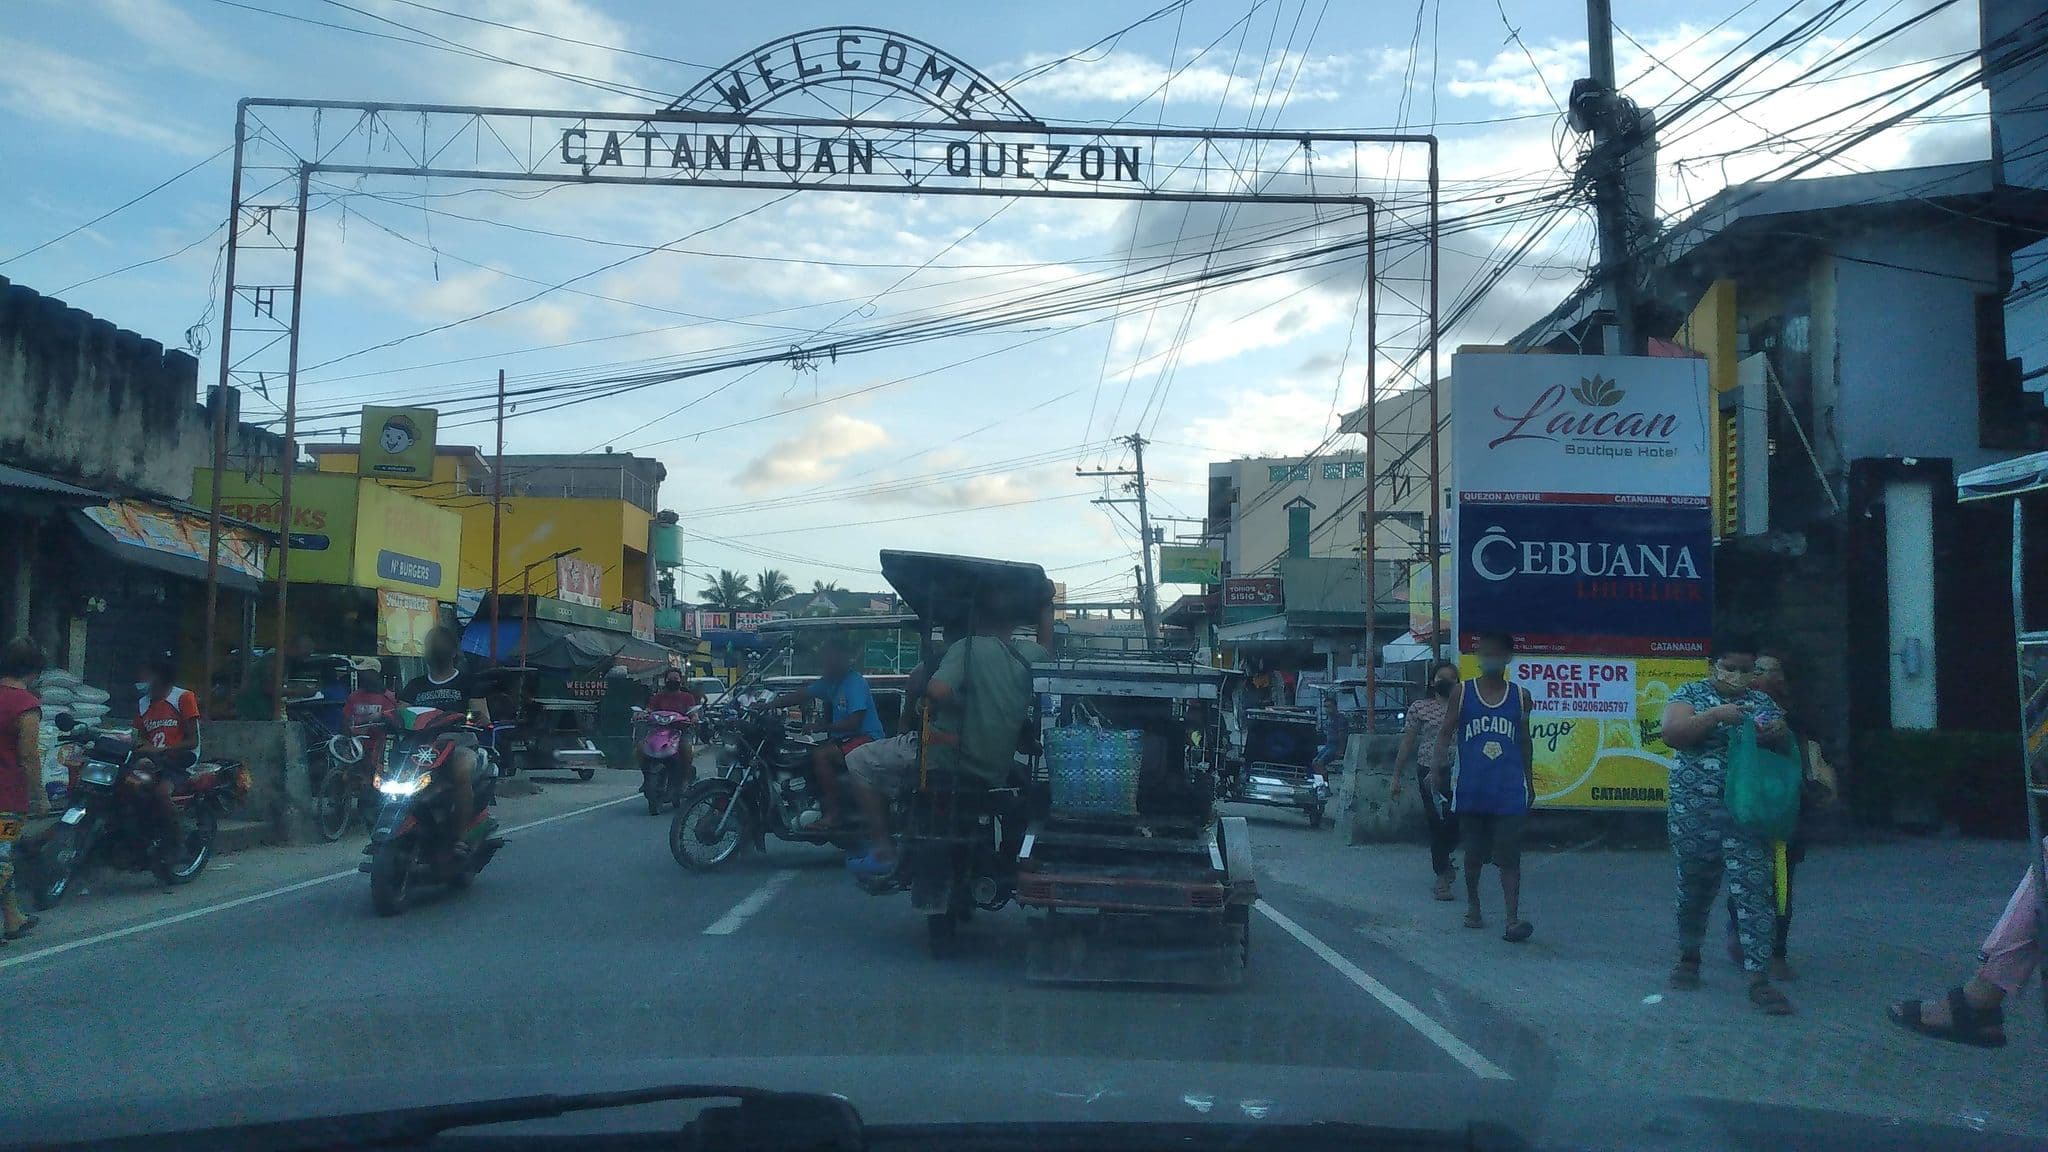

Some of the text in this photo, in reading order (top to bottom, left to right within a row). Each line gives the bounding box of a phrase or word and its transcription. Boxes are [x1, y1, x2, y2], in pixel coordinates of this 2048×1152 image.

[713, 35, 988, 118] WELCOME
[946, 141, 1139, 182] QUEZON
[1565, 443, 1633, 459] Boutique
[1463, 492, 1542, 501] QUEZON AVENUE
[1670, 496, 1708, 506] QUEZON
[1471, 525, 1702, 581] CEBUANA
[399, 561, 430, 580] BURGERS
[1230, 593, 1256, 601] SISIG
[1650, 641, 1703, 651] CATANAUAN
[1518, 663, 1629, 682] SPACE FOR
[566, 680, 609, 690] WELCOME
[1546, 681, 1601, 699] RENT
[1572, 701, 1629, 713] 09206205797
